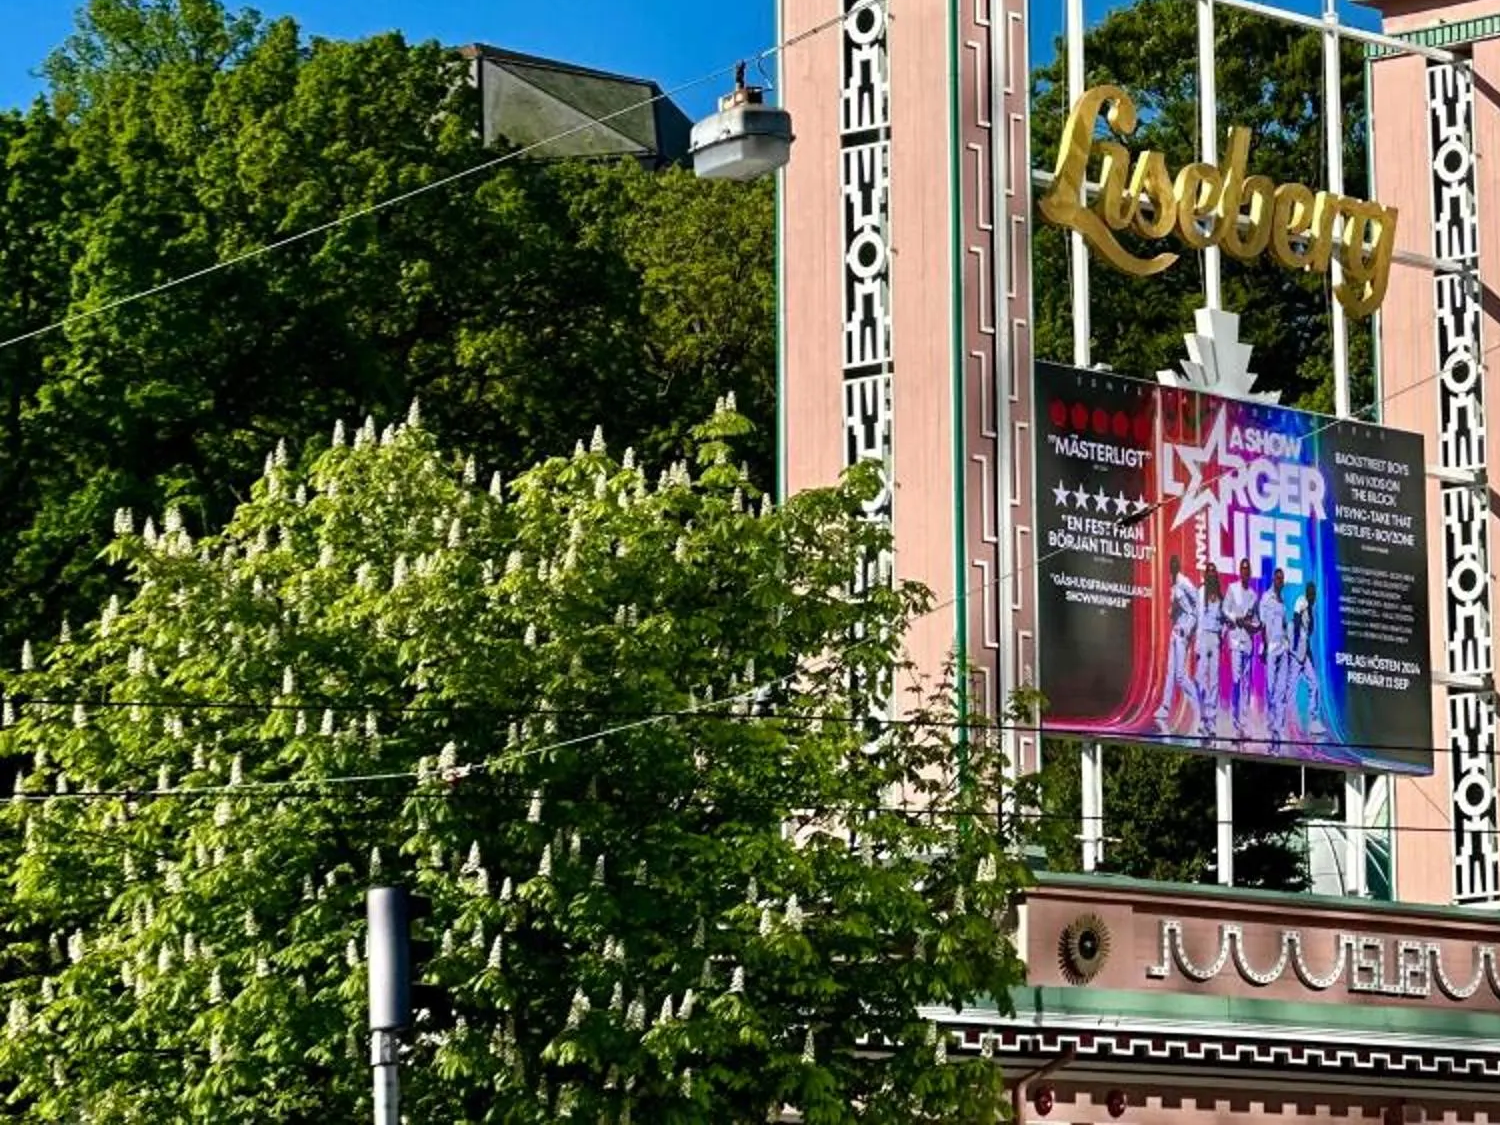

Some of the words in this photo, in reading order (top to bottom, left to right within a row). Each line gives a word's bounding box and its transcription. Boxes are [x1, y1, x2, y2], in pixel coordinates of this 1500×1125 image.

[1038, 85, 1398, 320] Liseberg
[1245, 428, 1302, 458] SHOW
[1048, 529, 1098, 554] BÖRJAN
[1100, 539, 1122, 557] TILL
[1207, 508, 1303, 583] LIFE
